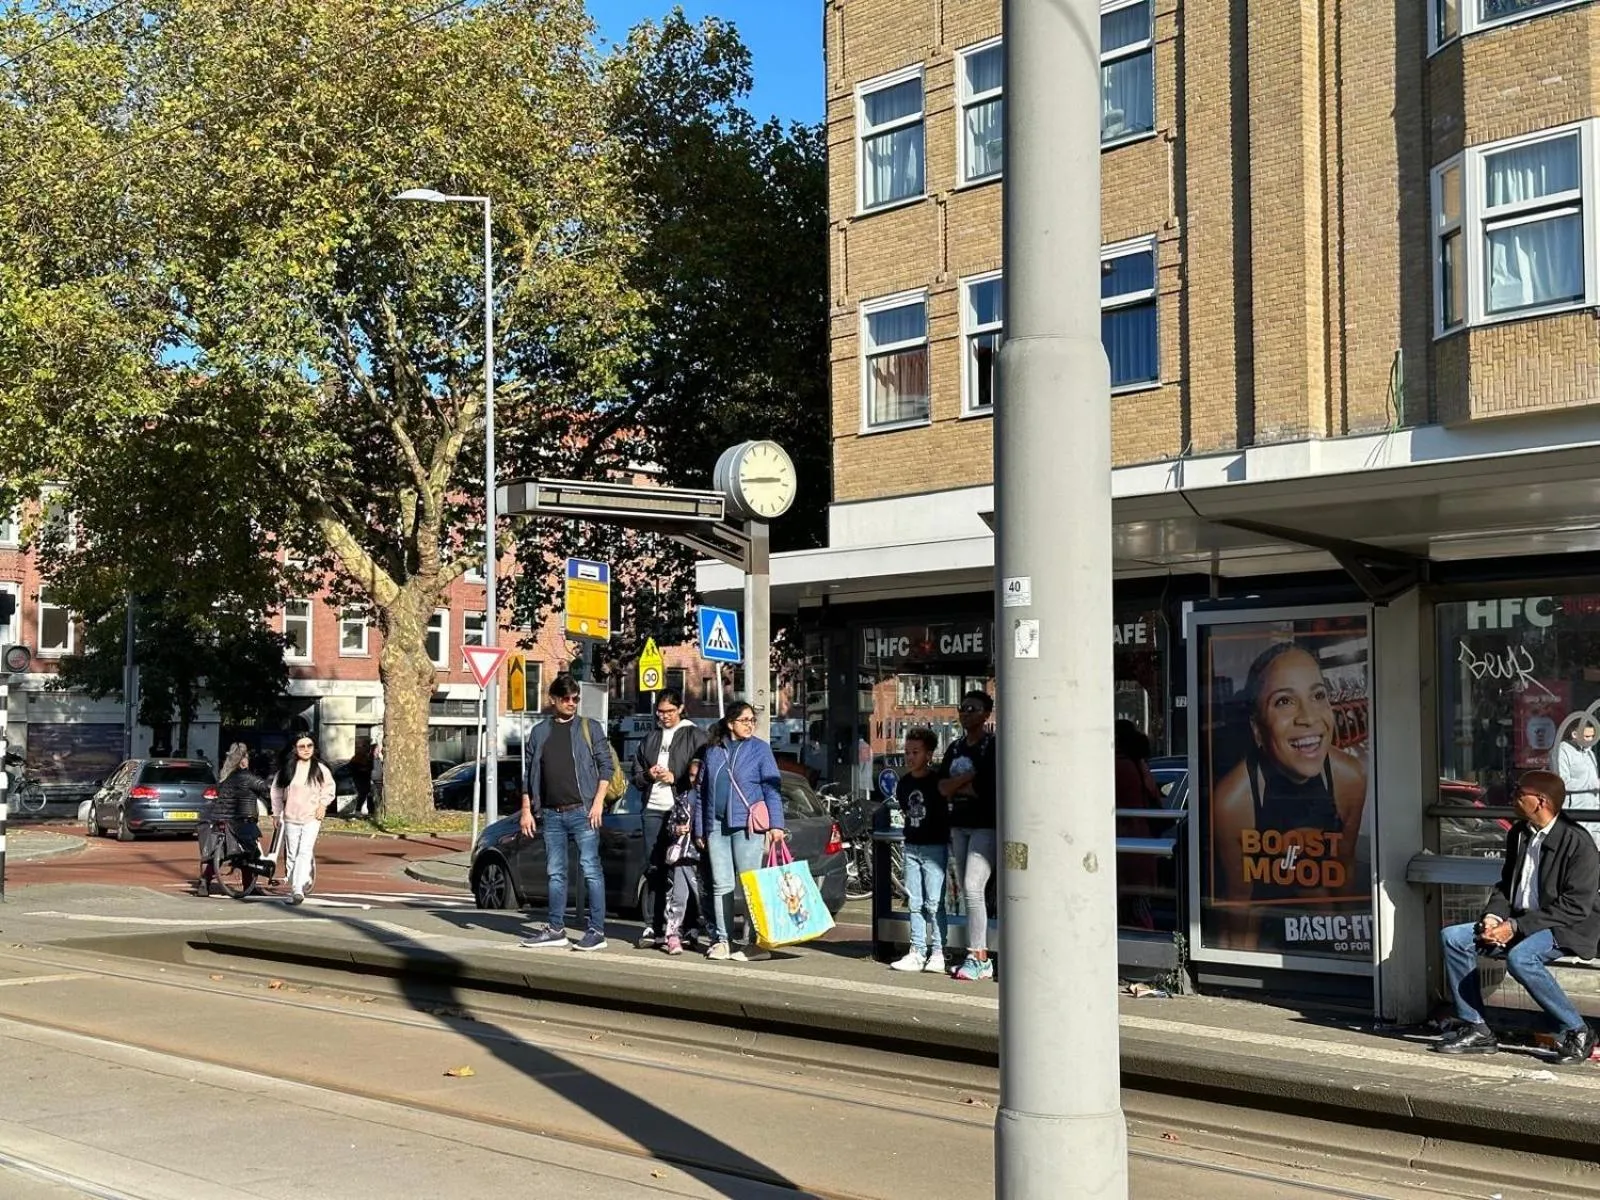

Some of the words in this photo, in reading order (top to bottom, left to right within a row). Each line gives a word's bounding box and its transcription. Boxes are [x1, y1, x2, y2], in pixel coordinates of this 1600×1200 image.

[1008, 580, 1021, 593] 40
[1467, 596, 1553, 630] HFC
[876, 636, 910, 658] HFC
[939, 627, 983, 655] CAFÉ
[1113, 616, 1147, 645] AFÉ
[645, 672, 657, 683] 30
[1241, 828, 1344, 857] BOOST
[1242, 857, 1346, 887] MOOD
[1280, 845, 1300, 870] JE
[1334, 942, 1348, 951] GO
[1350, 942, 1370, 951] FOR
